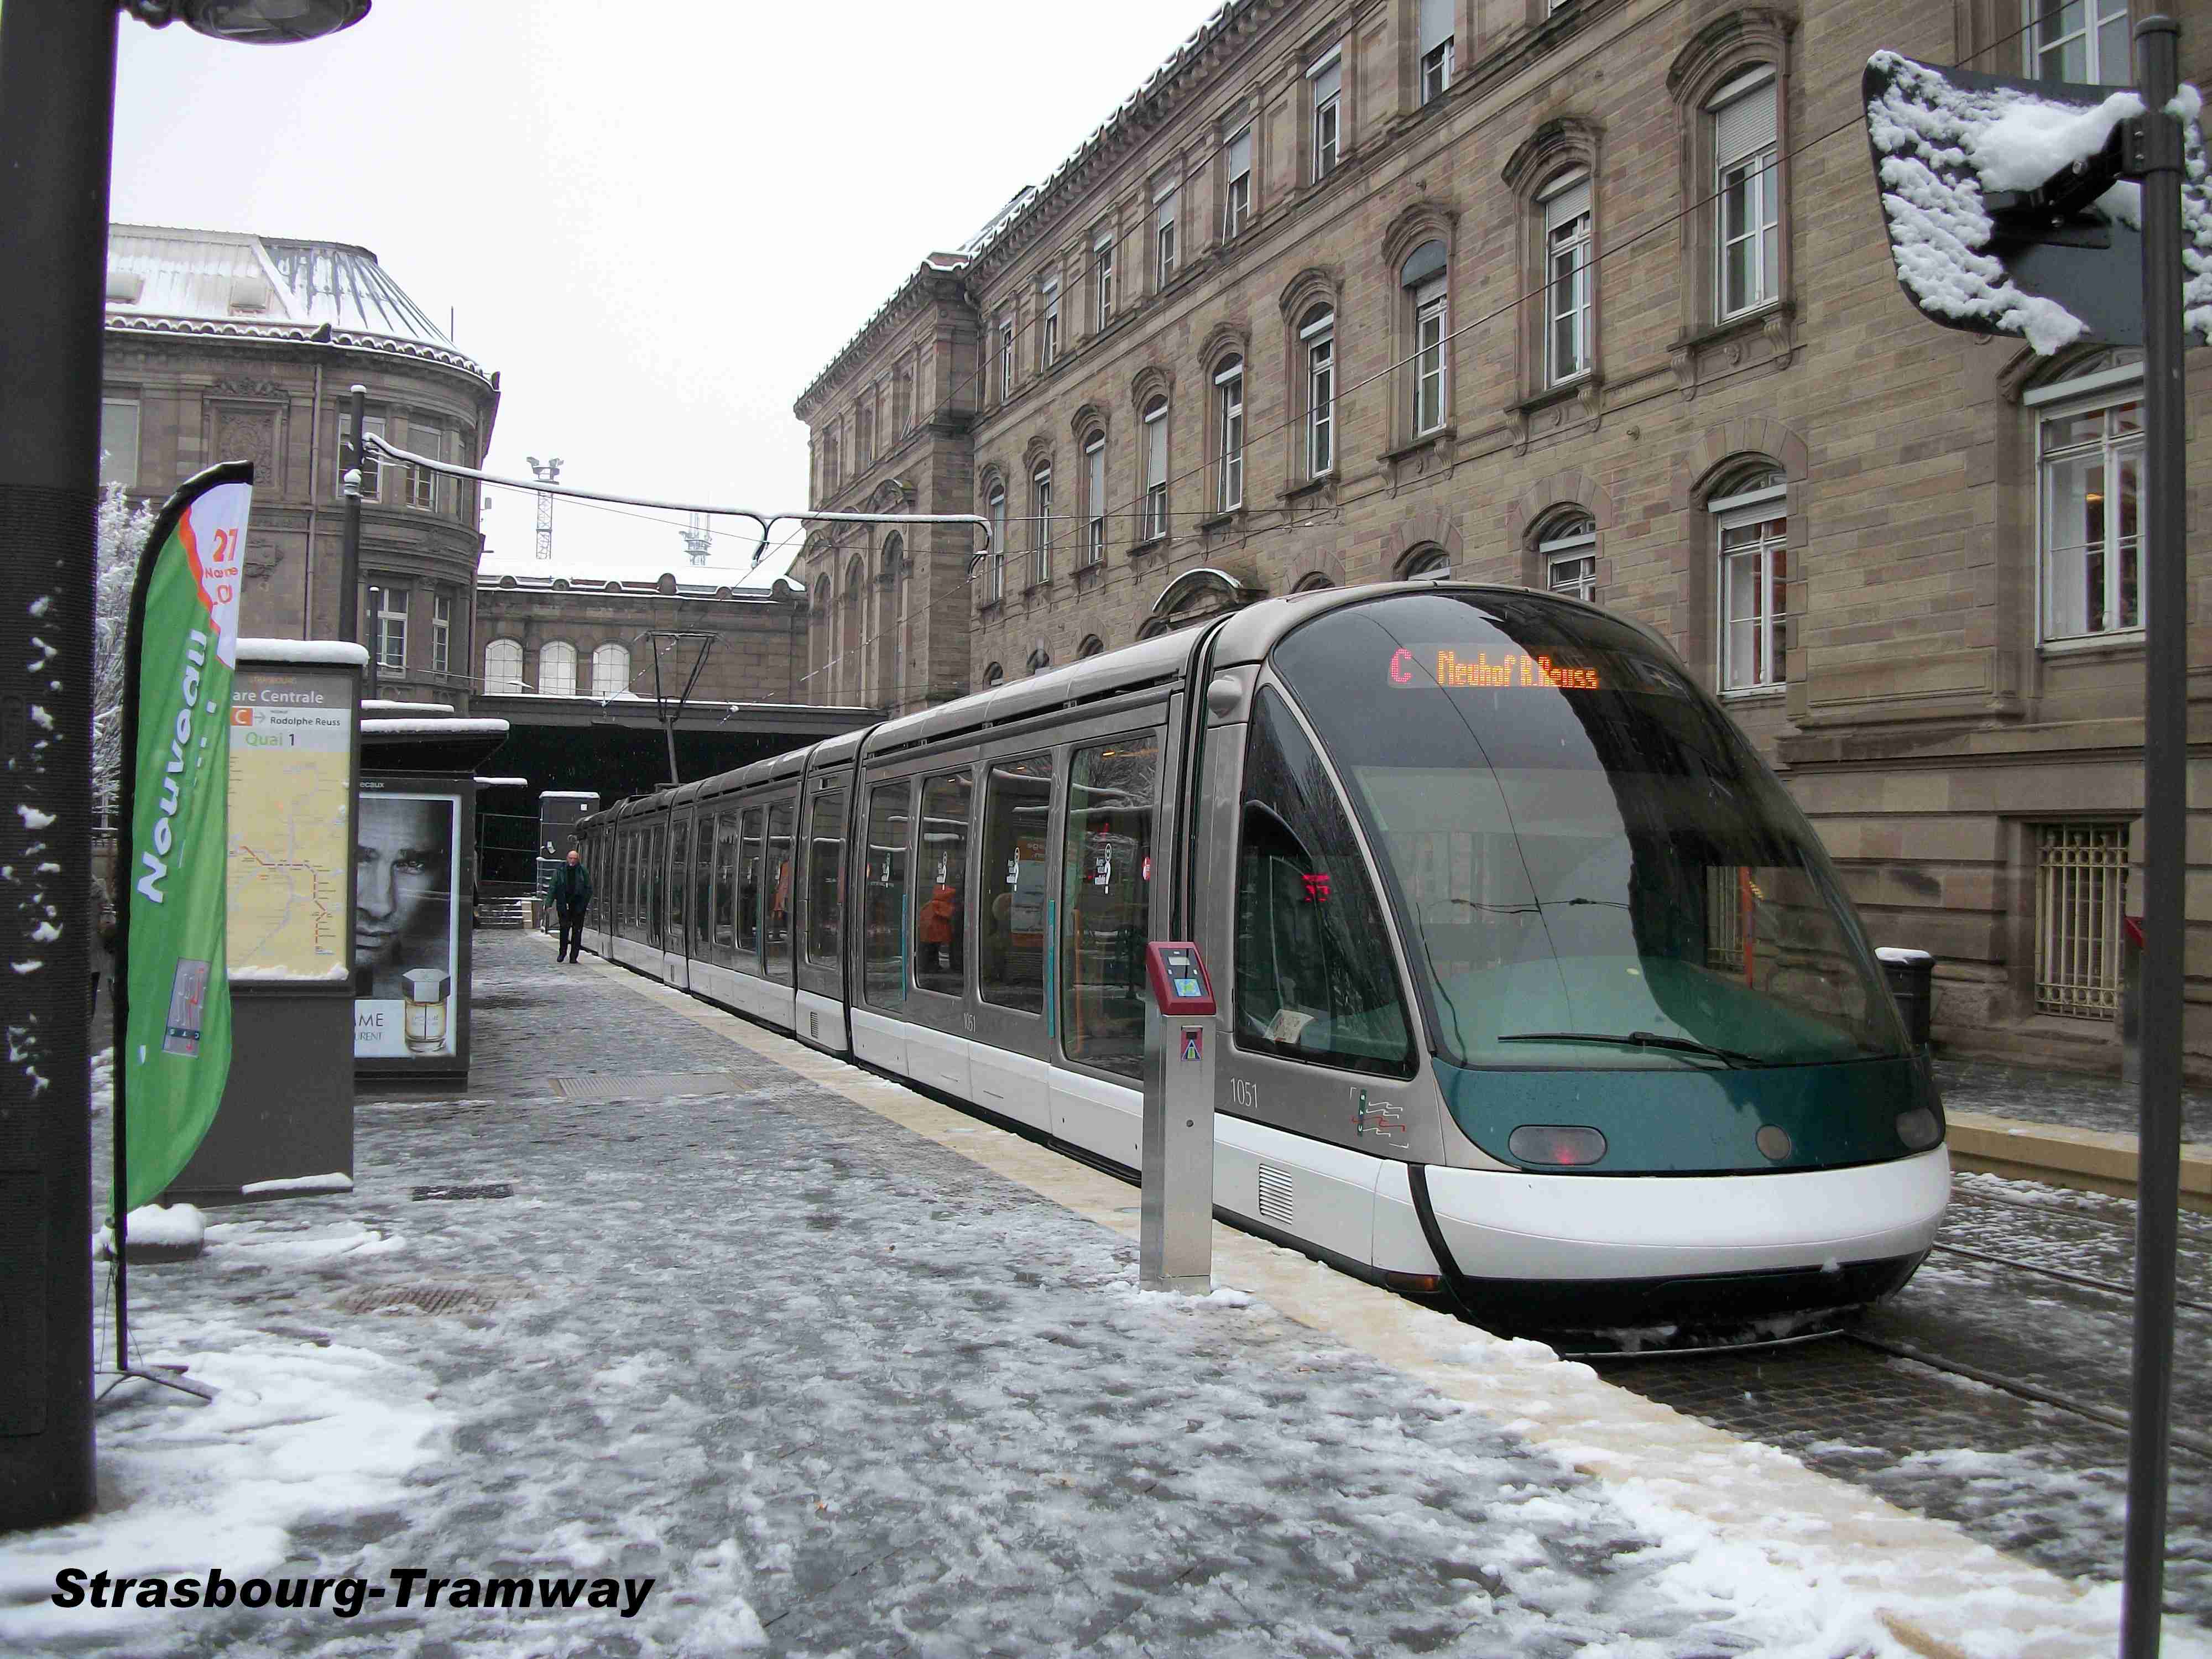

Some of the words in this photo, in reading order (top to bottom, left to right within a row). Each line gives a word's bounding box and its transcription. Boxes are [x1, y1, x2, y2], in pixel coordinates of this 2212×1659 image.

[1390, 648, 1412, 683] C
[232, 691, 256, 702] are
[260, 690, 324, 703] Centrale
[235, 709, 247, 724] C
[270, 717, 314, 726] Rodolphe
[315, 718, 341, 726] Reuss
[246, 732, 283, 747] Quai
[289, 733, 295, 746] 1
[354, 1013, 384, 1027] ME
[964, 1013, 976, 1033] 1051
[354, 1031, 385, 1041] URENT
[1230, 1077, 1258, 1109] 1051
